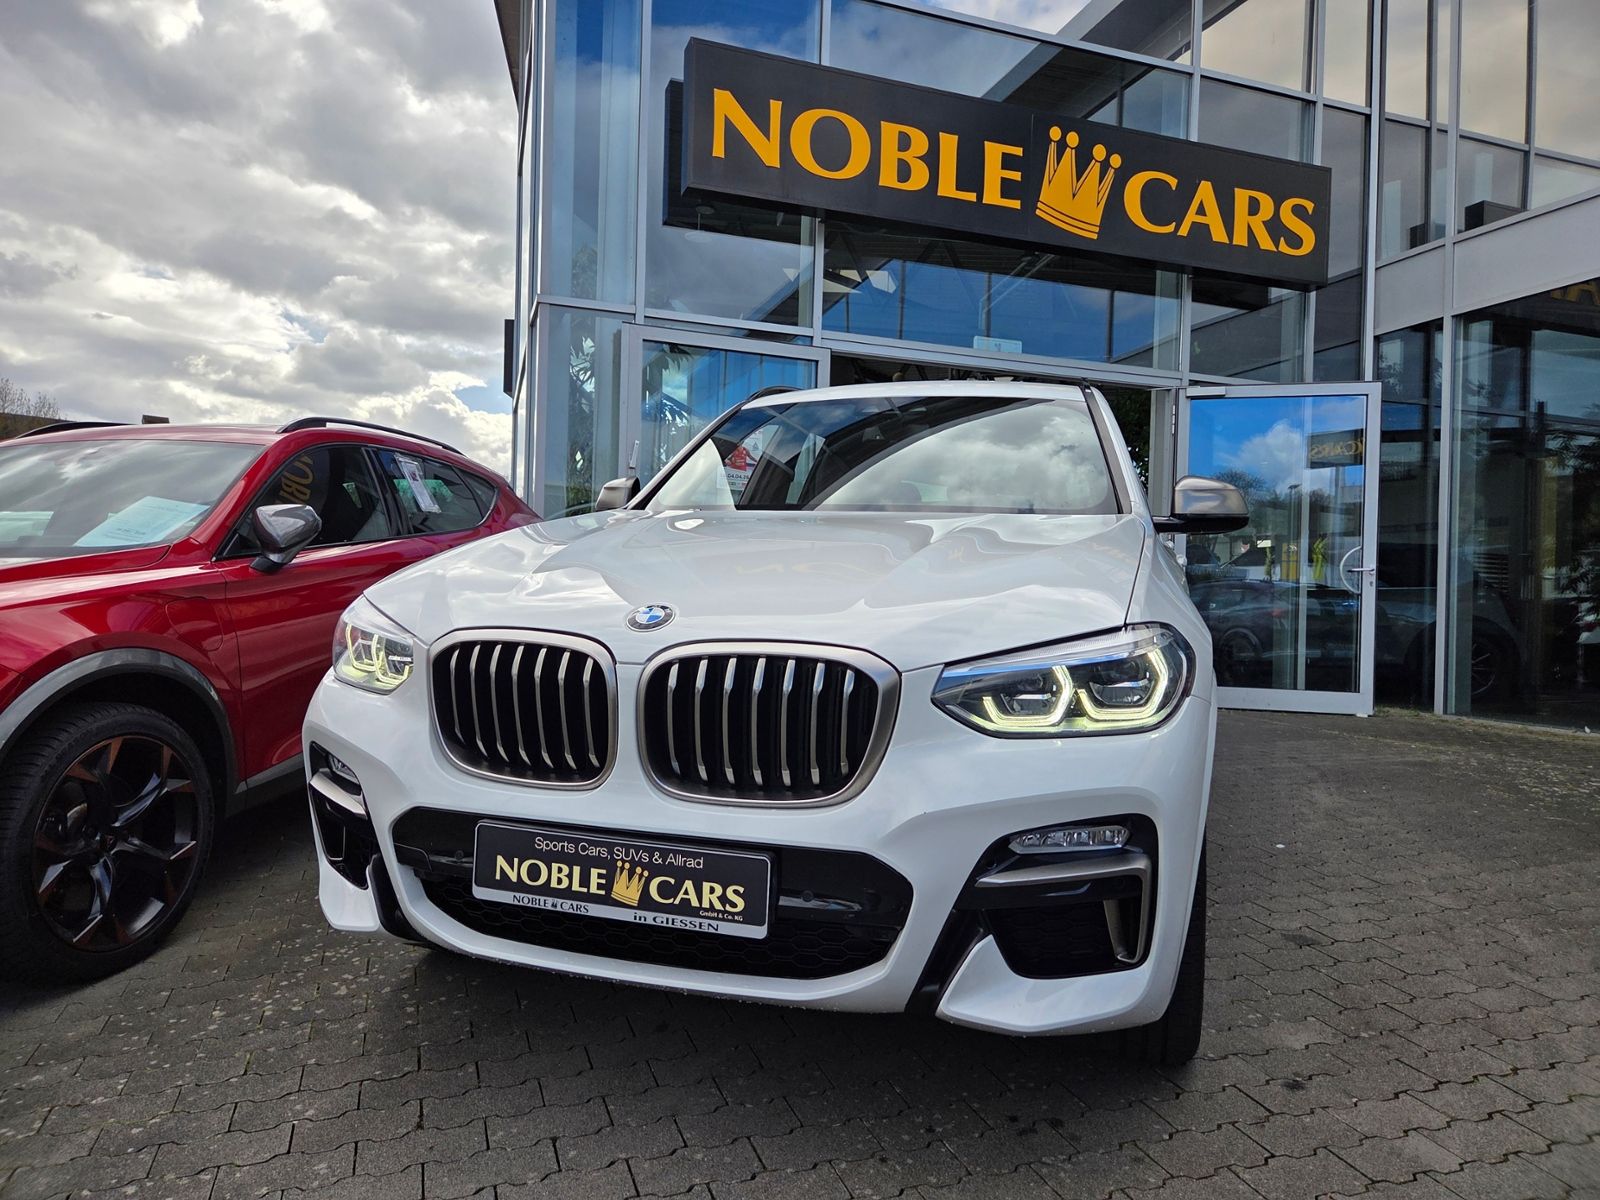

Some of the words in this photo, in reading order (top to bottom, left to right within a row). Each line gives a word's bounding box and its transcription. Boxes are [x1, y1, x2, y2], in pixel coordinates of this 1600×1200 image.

[711, 87, 1024, 211] NOBLE
[1123, 170, 1316, 257] CARS
[534, 836, 576, 853] Sports
[578, 842, 611, 860] Cars,
[613, 846, 650, 862] SUVs
[652, 851, 663, 864] &
[665, 853, 704, 869] Allrad
[495, 855, 607, 895] NOBLE
[650, 876, 745, 912] CARS
[512, 894, 549, 908] NOBLE
[560, 901, 589, 913] CARS
[633, 911, 647, 922] in
[652, 915, 719, 931] GIESSEN
